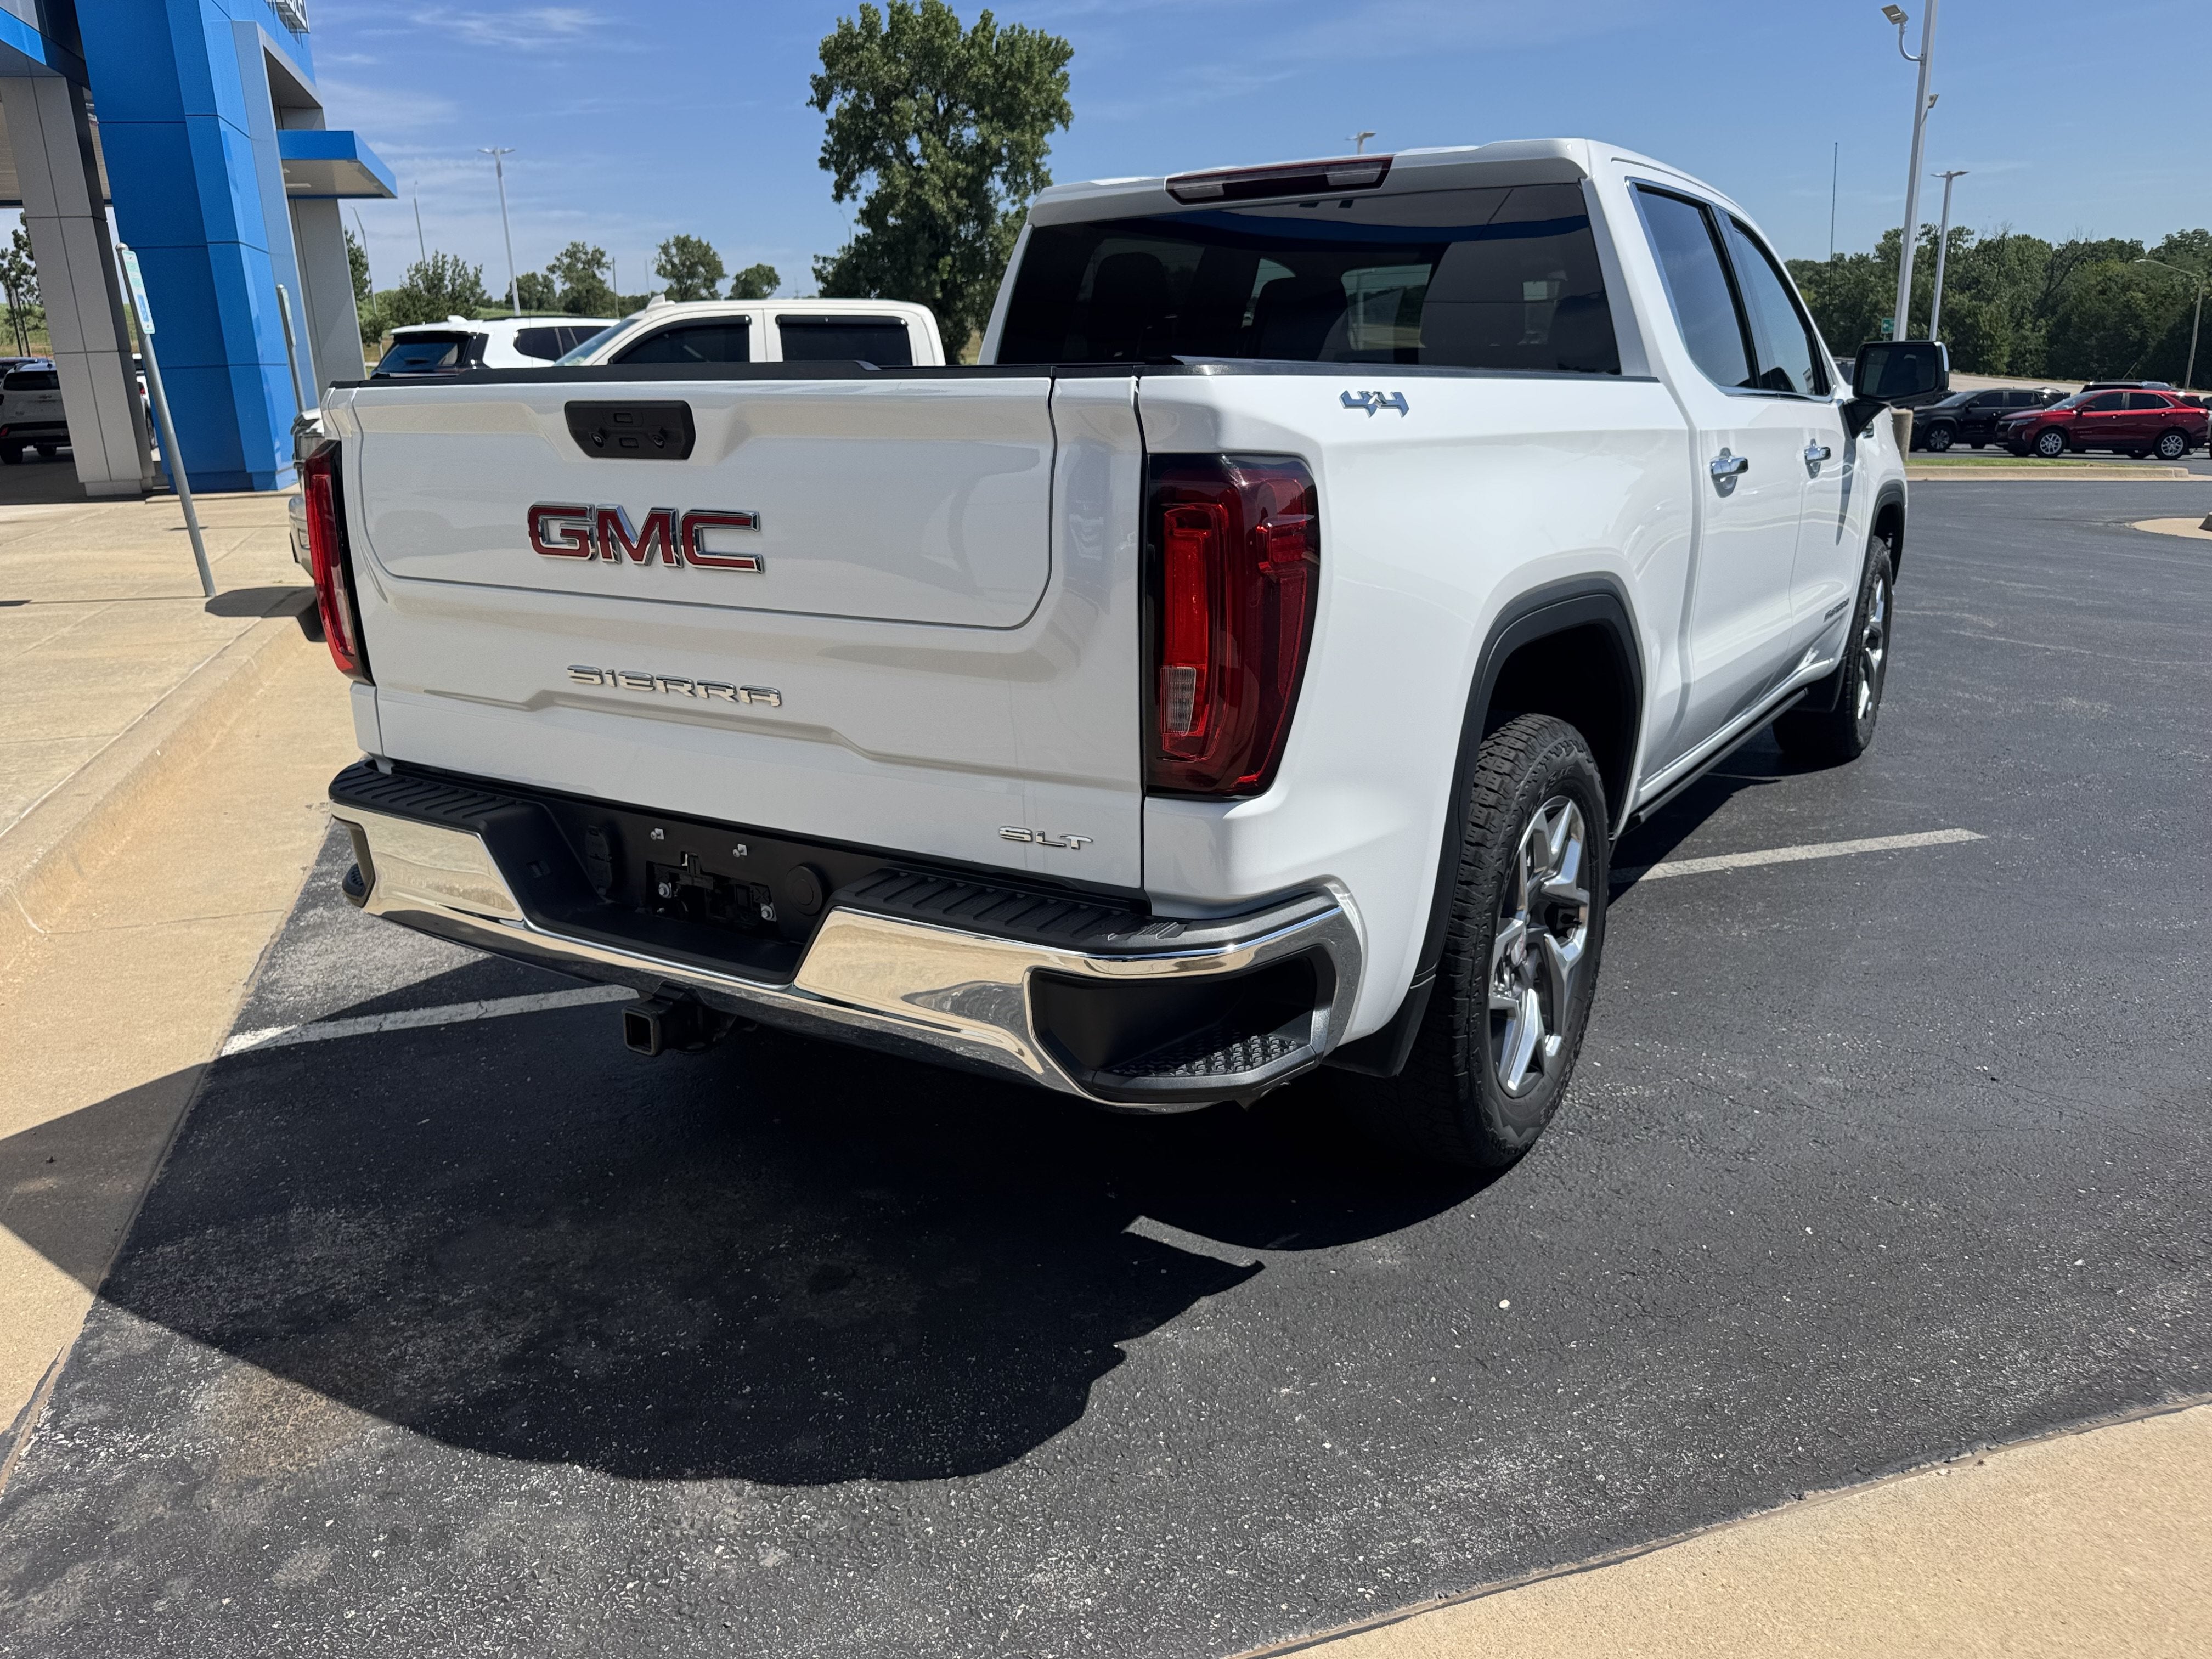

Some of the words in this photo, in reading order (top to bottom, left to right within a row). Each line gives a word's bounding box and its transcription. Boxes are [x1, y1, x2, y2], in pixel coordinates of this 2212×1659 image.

[528, 501, 764, 574] GMC
[567, 664, 782, 707] SIERRA
[998, 825, 1093, 850] SLT
